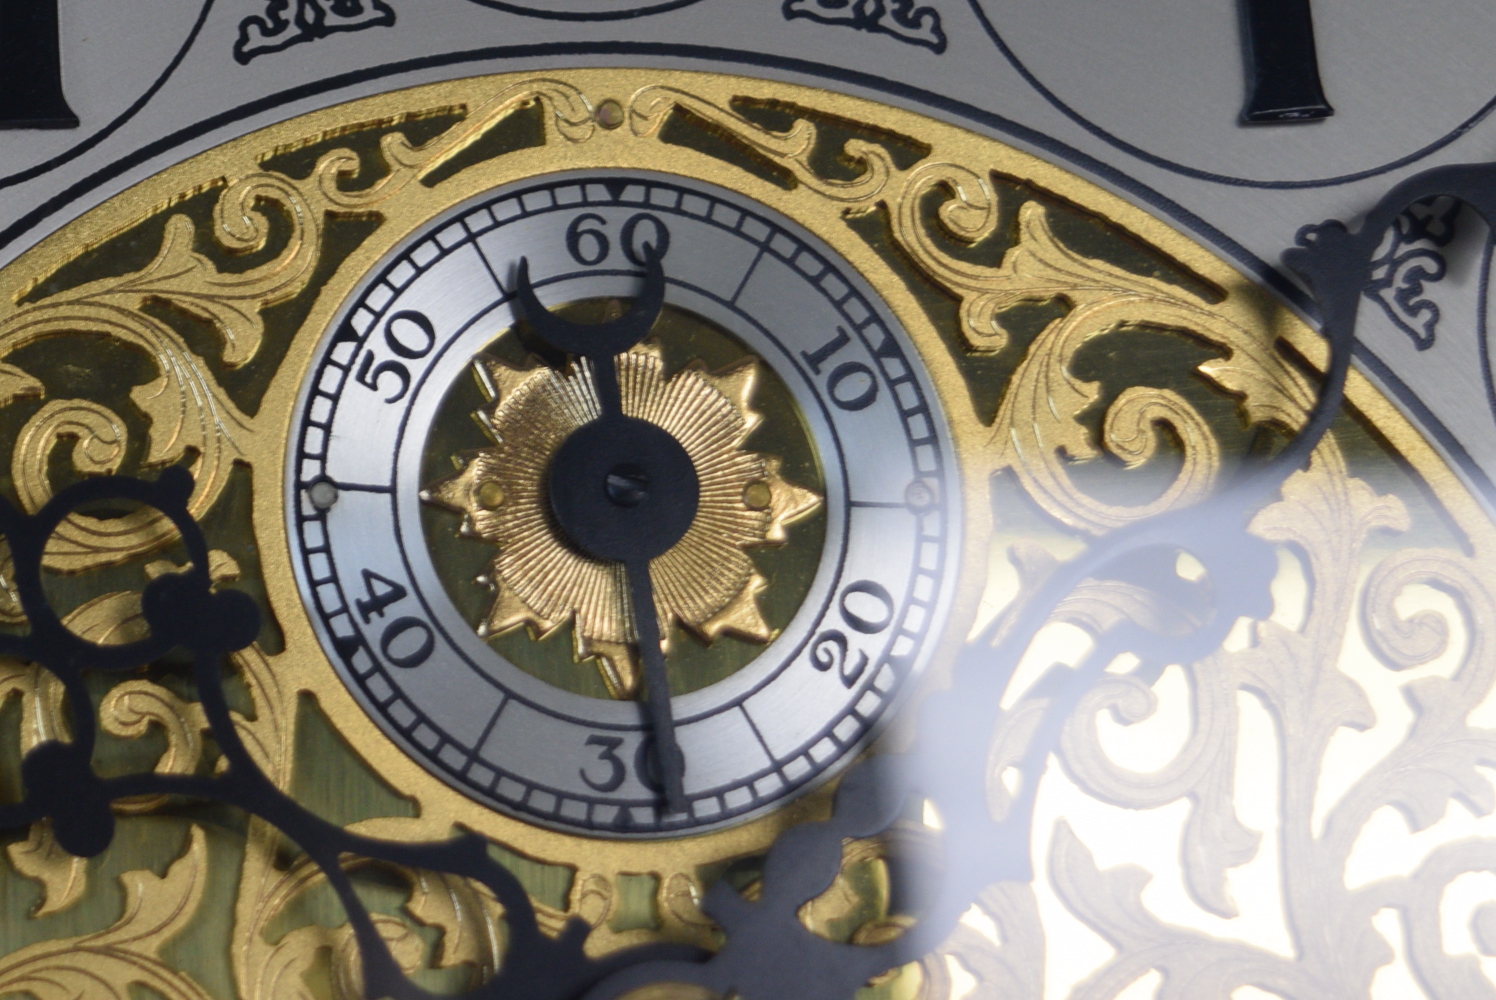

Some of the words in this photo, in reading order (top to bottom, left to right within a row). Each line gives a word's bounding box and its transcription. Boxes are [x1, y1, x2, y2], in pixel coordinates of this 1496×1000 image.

[566, 213, 670, 266] 60
[356, 310, 436, 403] 50
[800, 328, 878, 411] 10
[355, 568, 435, 668] 40
[810, 579, 894, 689] 20
